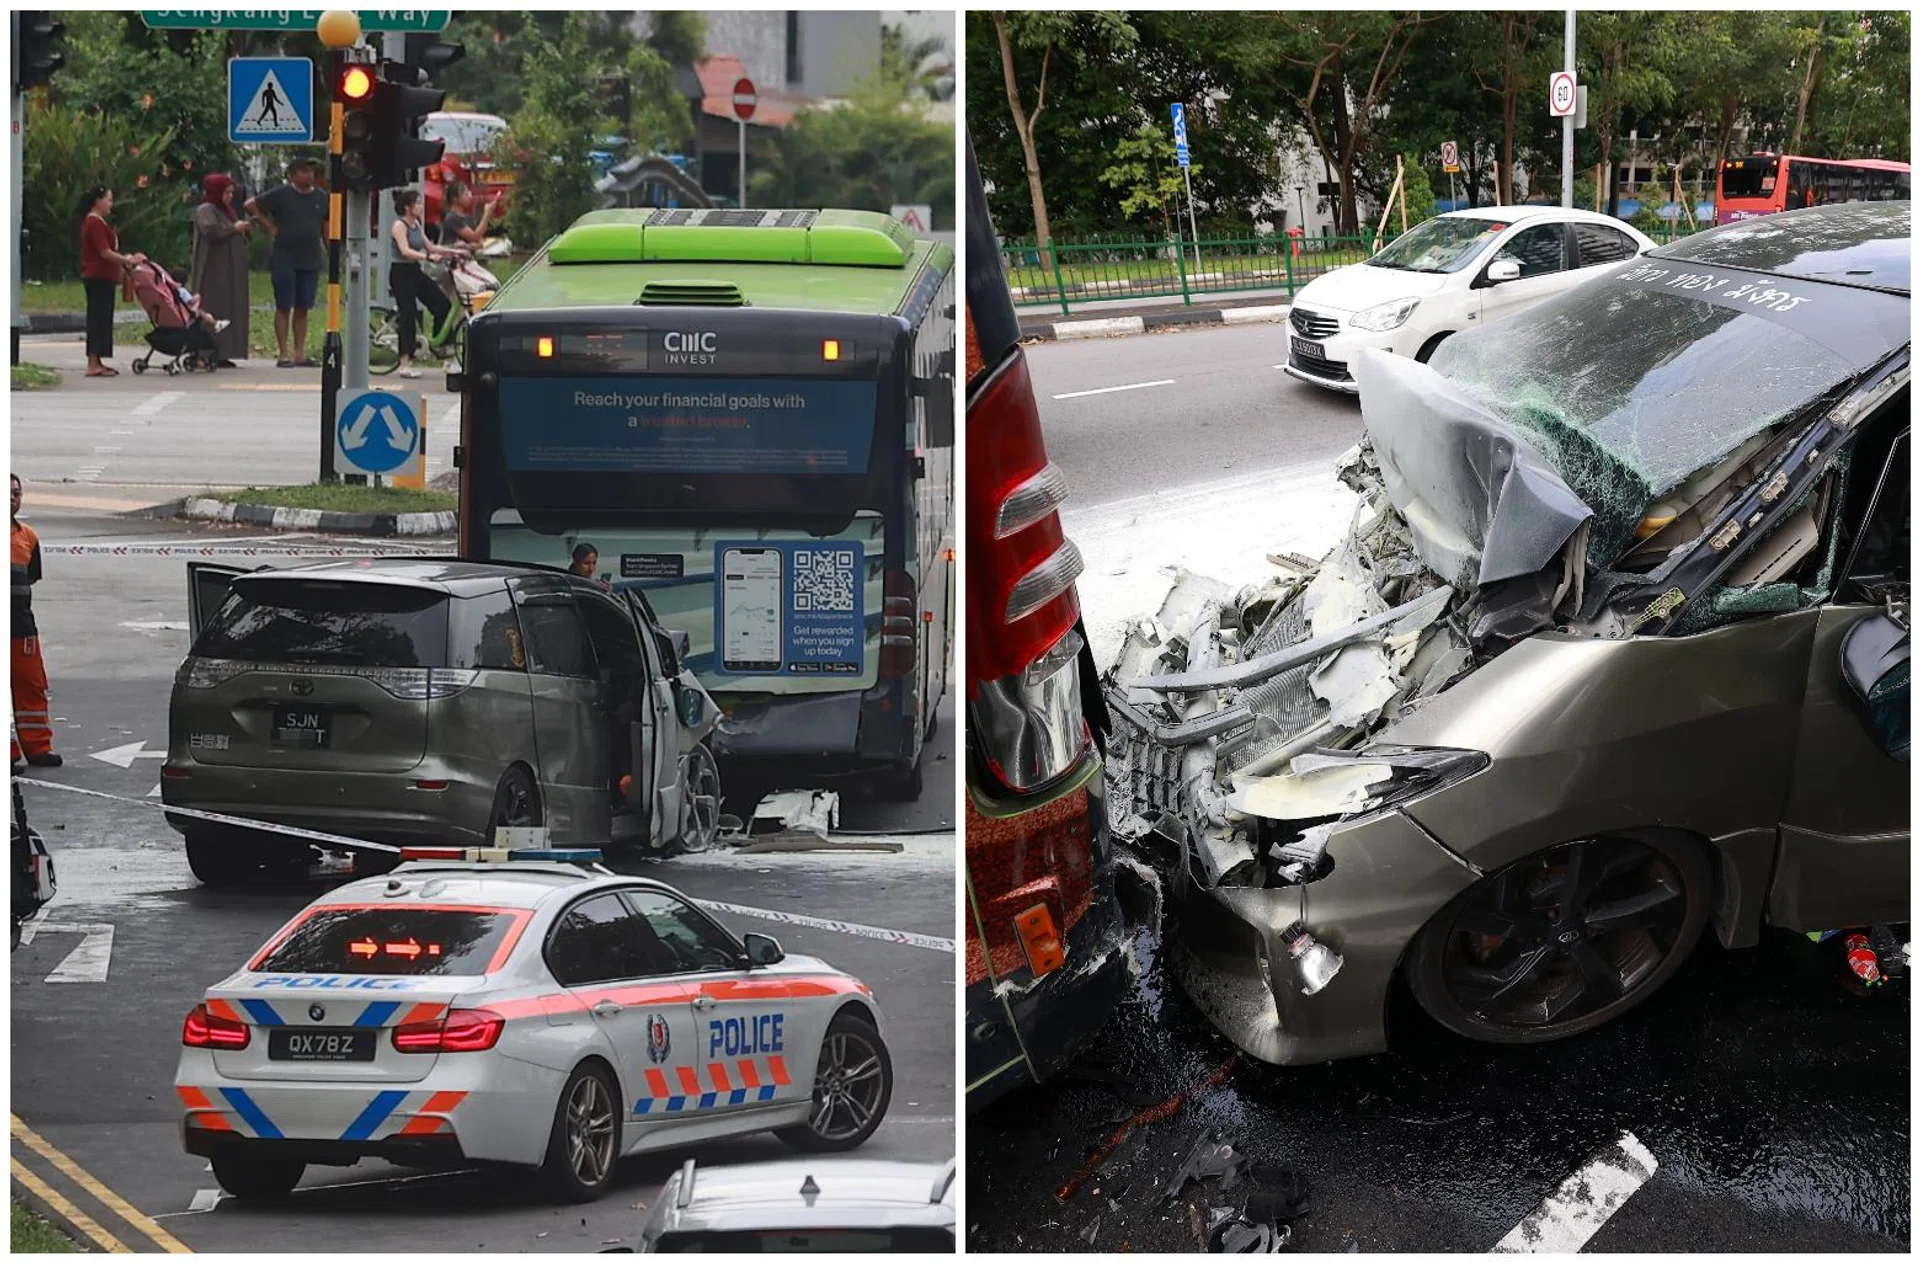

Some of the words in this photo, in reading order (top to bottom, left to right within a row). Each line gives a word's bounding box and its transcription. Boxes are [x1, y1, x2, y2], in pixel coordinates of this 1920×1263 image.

[378, 10, 431, 28] Way
[1558, 85, 1568, 102] 60
[327, 352, 336, 369] 4
[664, 354, 717, 365] INVEST
[574, 391, 624, 406] Reach
[625, 395, 661, 409] your
[662, 392, 727, 408] financial
[728, 393, 771, 410] goals
[772, 394, 805, 409] with
[628, 417, 638, 428] a
[793, 625, 810, 635] Get
[811, 625, 854, 636] rewarded
[792, 637, 817, 646] when
[818, 639, 835, 647] you
[804, 648, 816, 657] up
[817, 646, 842, 658] today
[286, 712, 319, 728] SJN
[254, 977, 421, 990] POLICE
[289, 1035, 354, 1053] QX78Z
[709, 1013, 784, 1059] POLICE
